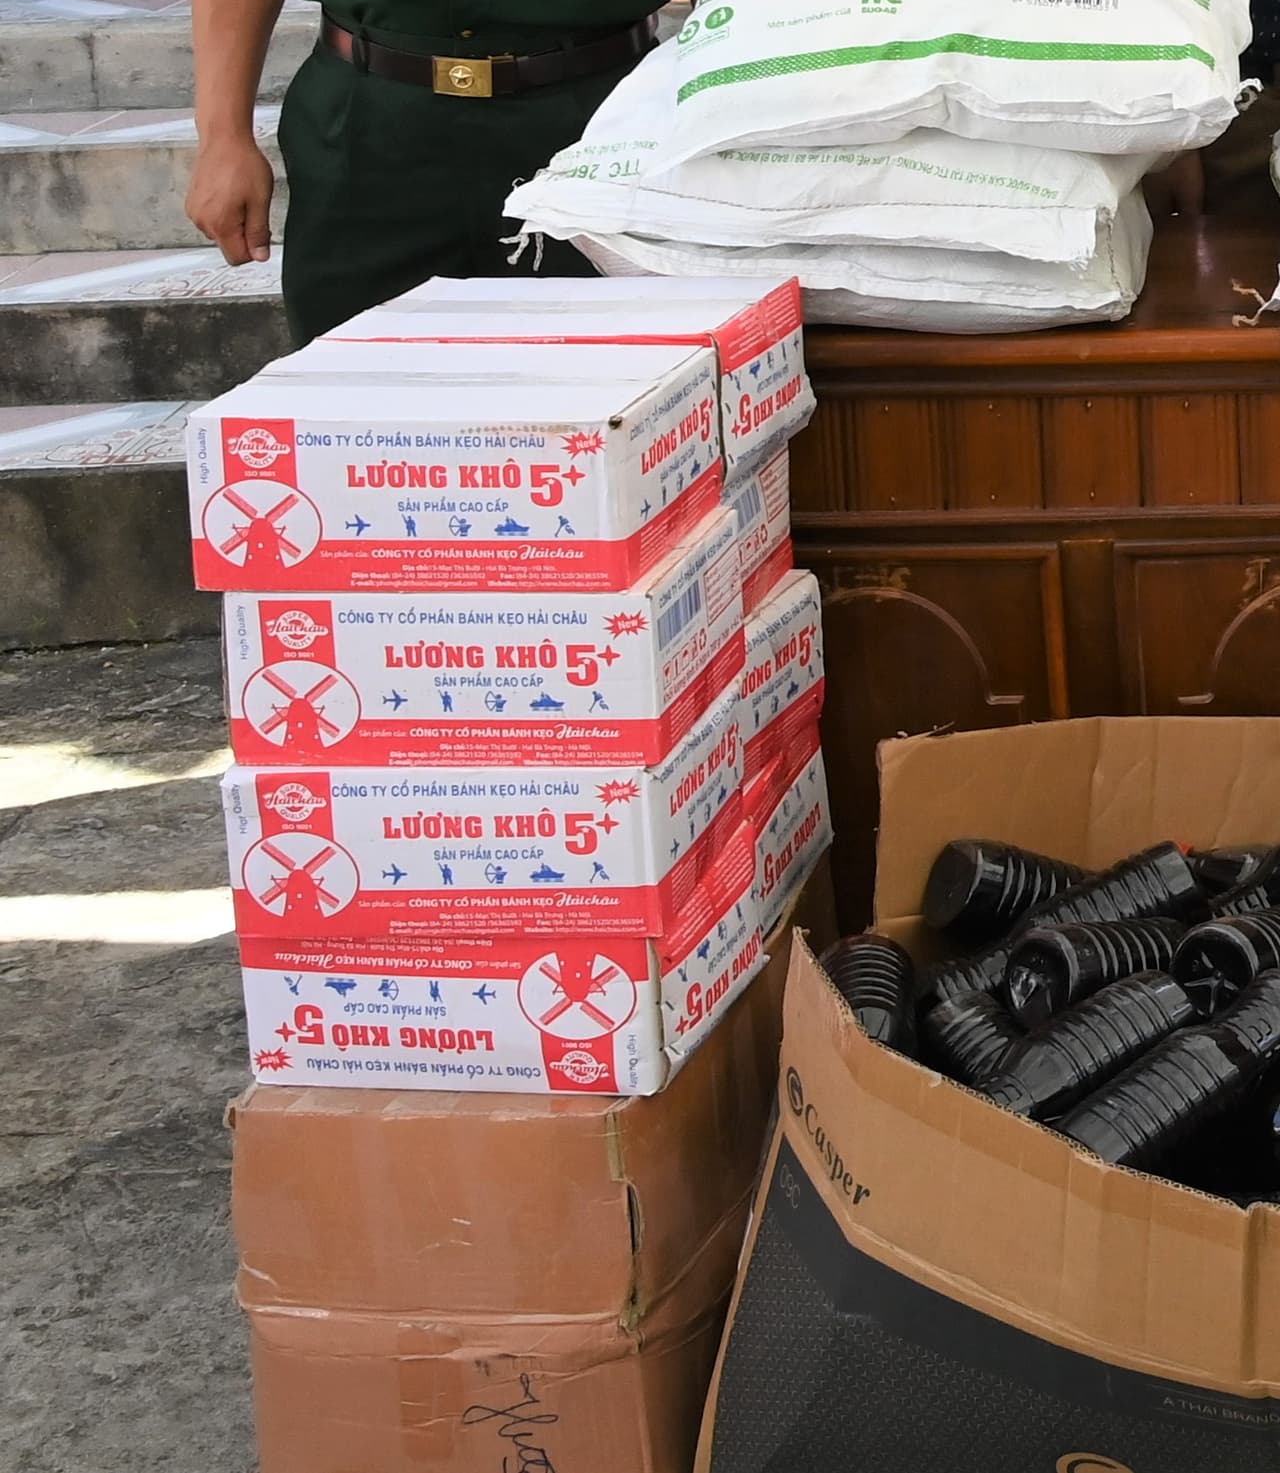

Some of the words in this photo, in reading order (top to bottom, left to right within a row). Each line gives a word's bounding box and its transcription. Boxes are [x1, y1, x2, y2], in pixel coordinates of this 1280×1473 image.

[198, 428, 209, 457] Quality
[296, 434, 331, 446] CÔNG
[336, 436, 350, 446] TY
[356, 430, 374, 447] CỔ
[377, 431, 412, 446] PHẦN
[416, 433, 449, 447] BÁNH
[455, 436, 481, 449] KẸO
[485, 431, 506, 447] HẢI
[509, 434, 545, 448] CHÂU
[200, 460, 209, 483] High
[347, 459, 447, 488] LƯƠNG
[459, 458, 521, 488] KHÔ
[530, 464, 586, 507] 5+
[398, 498, 420, 513] SẢN
[424, 497, 456, 513] PHẨM
[461, 501, 482, 513] CAO
[486, 497, 509, 513] CẤP
[385, 641, 484, 669] LƯƠNG
[496, 639, 557, 668] KHÔ
[565, 643, 622, 687] 5+
[332, 1024, 390, 1049] KHÔ
[399, 1026, 494, 1053] LƯƠNG
[804, 1104, 870, 1205] Casper
[1164, 1397, 1174, 1406] A
[1179, 1399, 1217, 1416] THAI
[1222, 1408, 1280, 1424] BRAND
